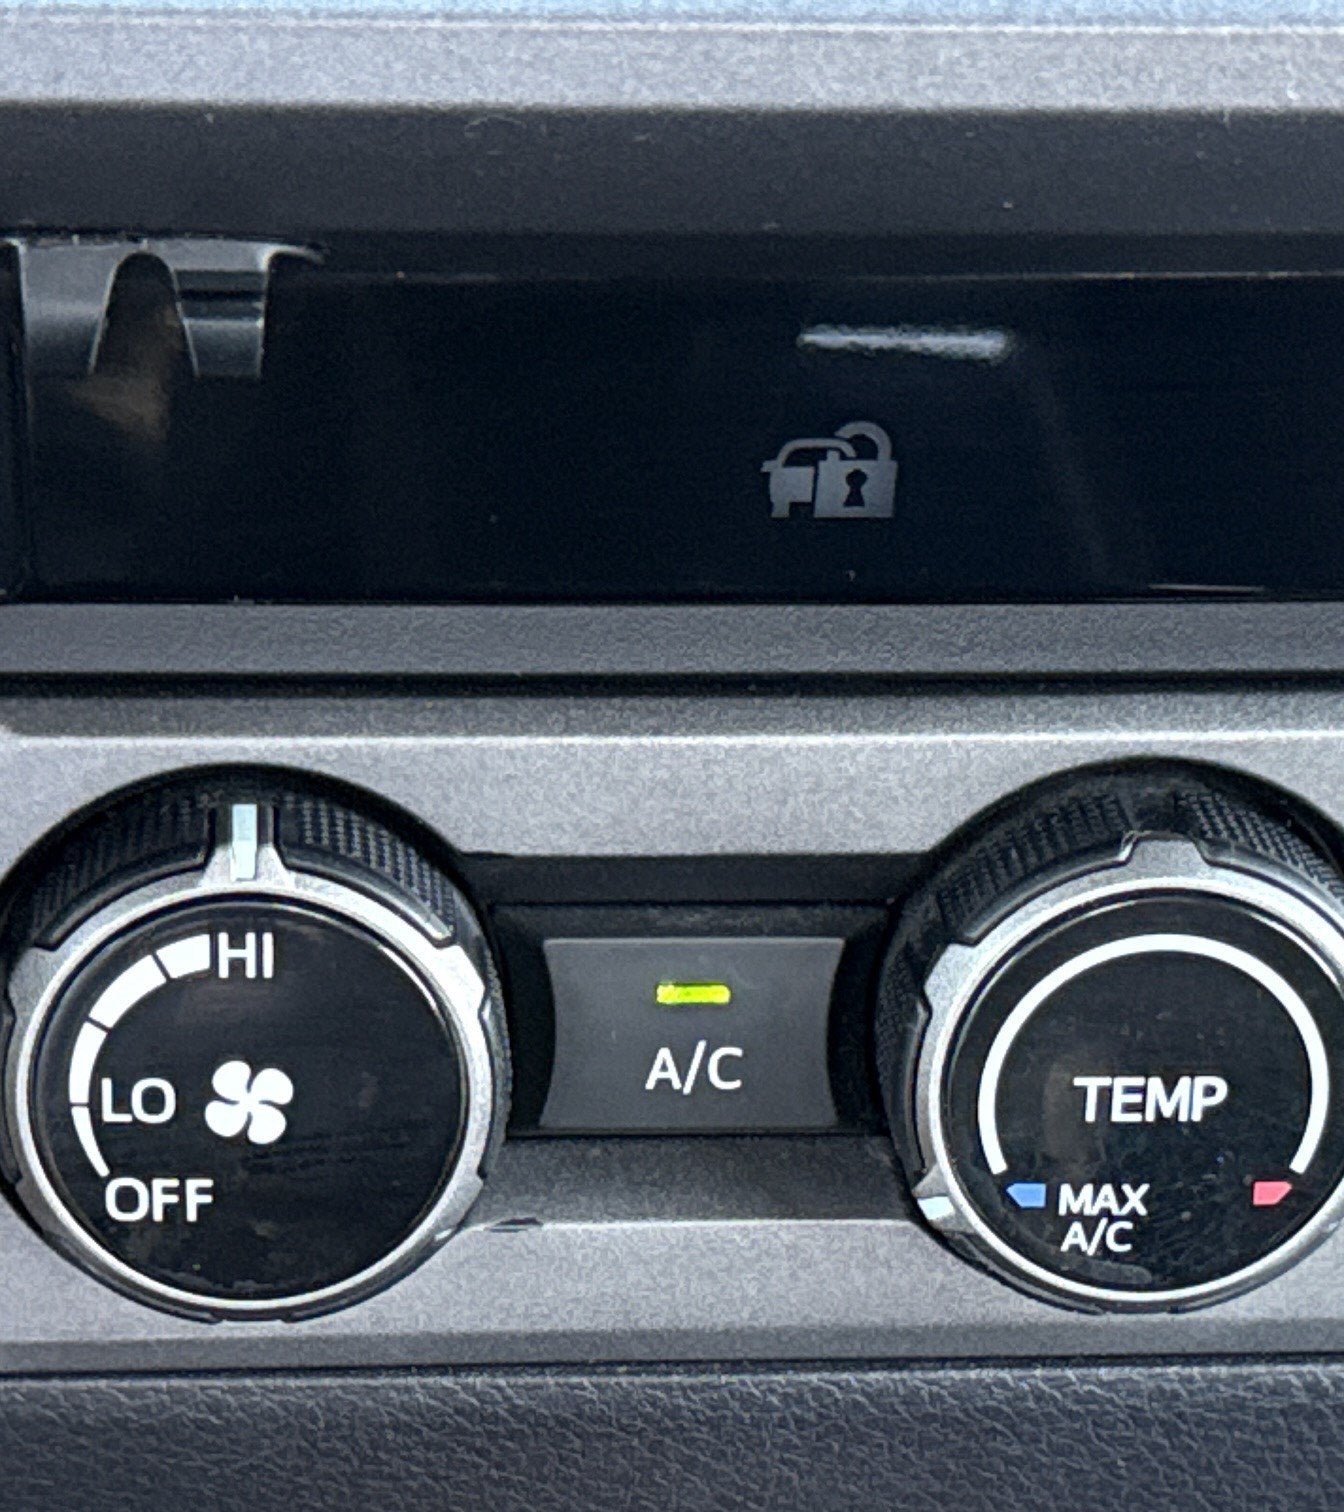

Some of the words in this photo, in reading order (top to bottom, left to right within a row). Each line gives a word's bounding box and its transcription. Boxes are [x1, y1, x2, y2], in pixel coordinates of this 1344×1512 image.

[217, 932, 274, 979] HI
[644, 1039, 743, 1095] A/C
[101, 1077, 177, 1124] LO
[1072, 1075, 1229, 1124] TEMP
[103, 1178, 214, 1224] OFF
[1058, 1182, 1151, 1217] MAX
[1060, 1217, 1135, 1256] A/C
